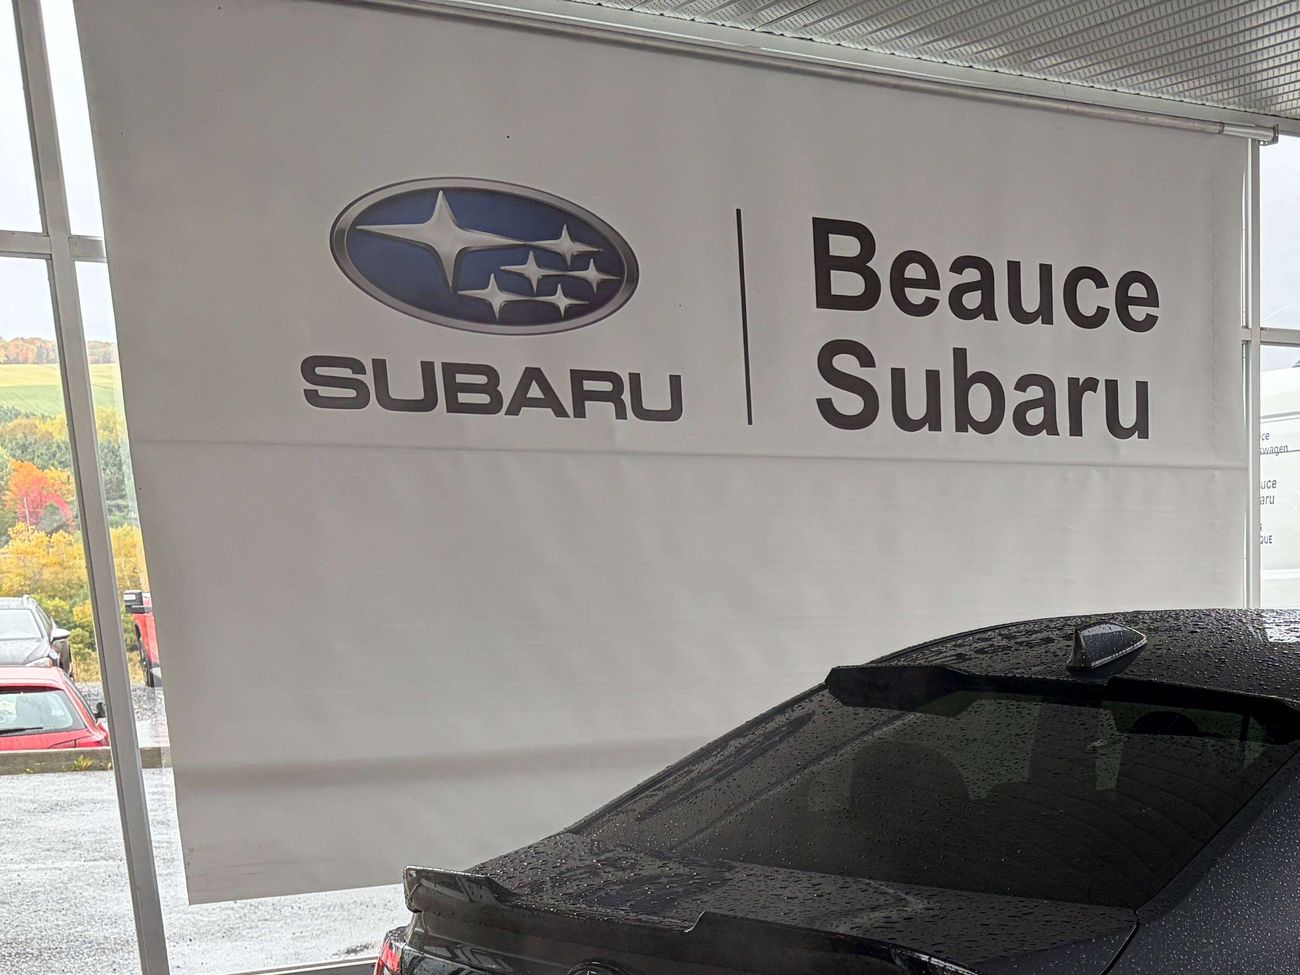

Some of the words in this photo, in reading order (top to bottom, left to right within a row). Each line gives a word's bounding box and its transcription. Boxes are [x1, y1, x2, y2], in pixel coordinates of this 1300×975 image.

[812, 216, 1161, 333] Beauce
[300, 355, 684, 422] SUBARU
[816, 338, 1151, 441] Subaru
